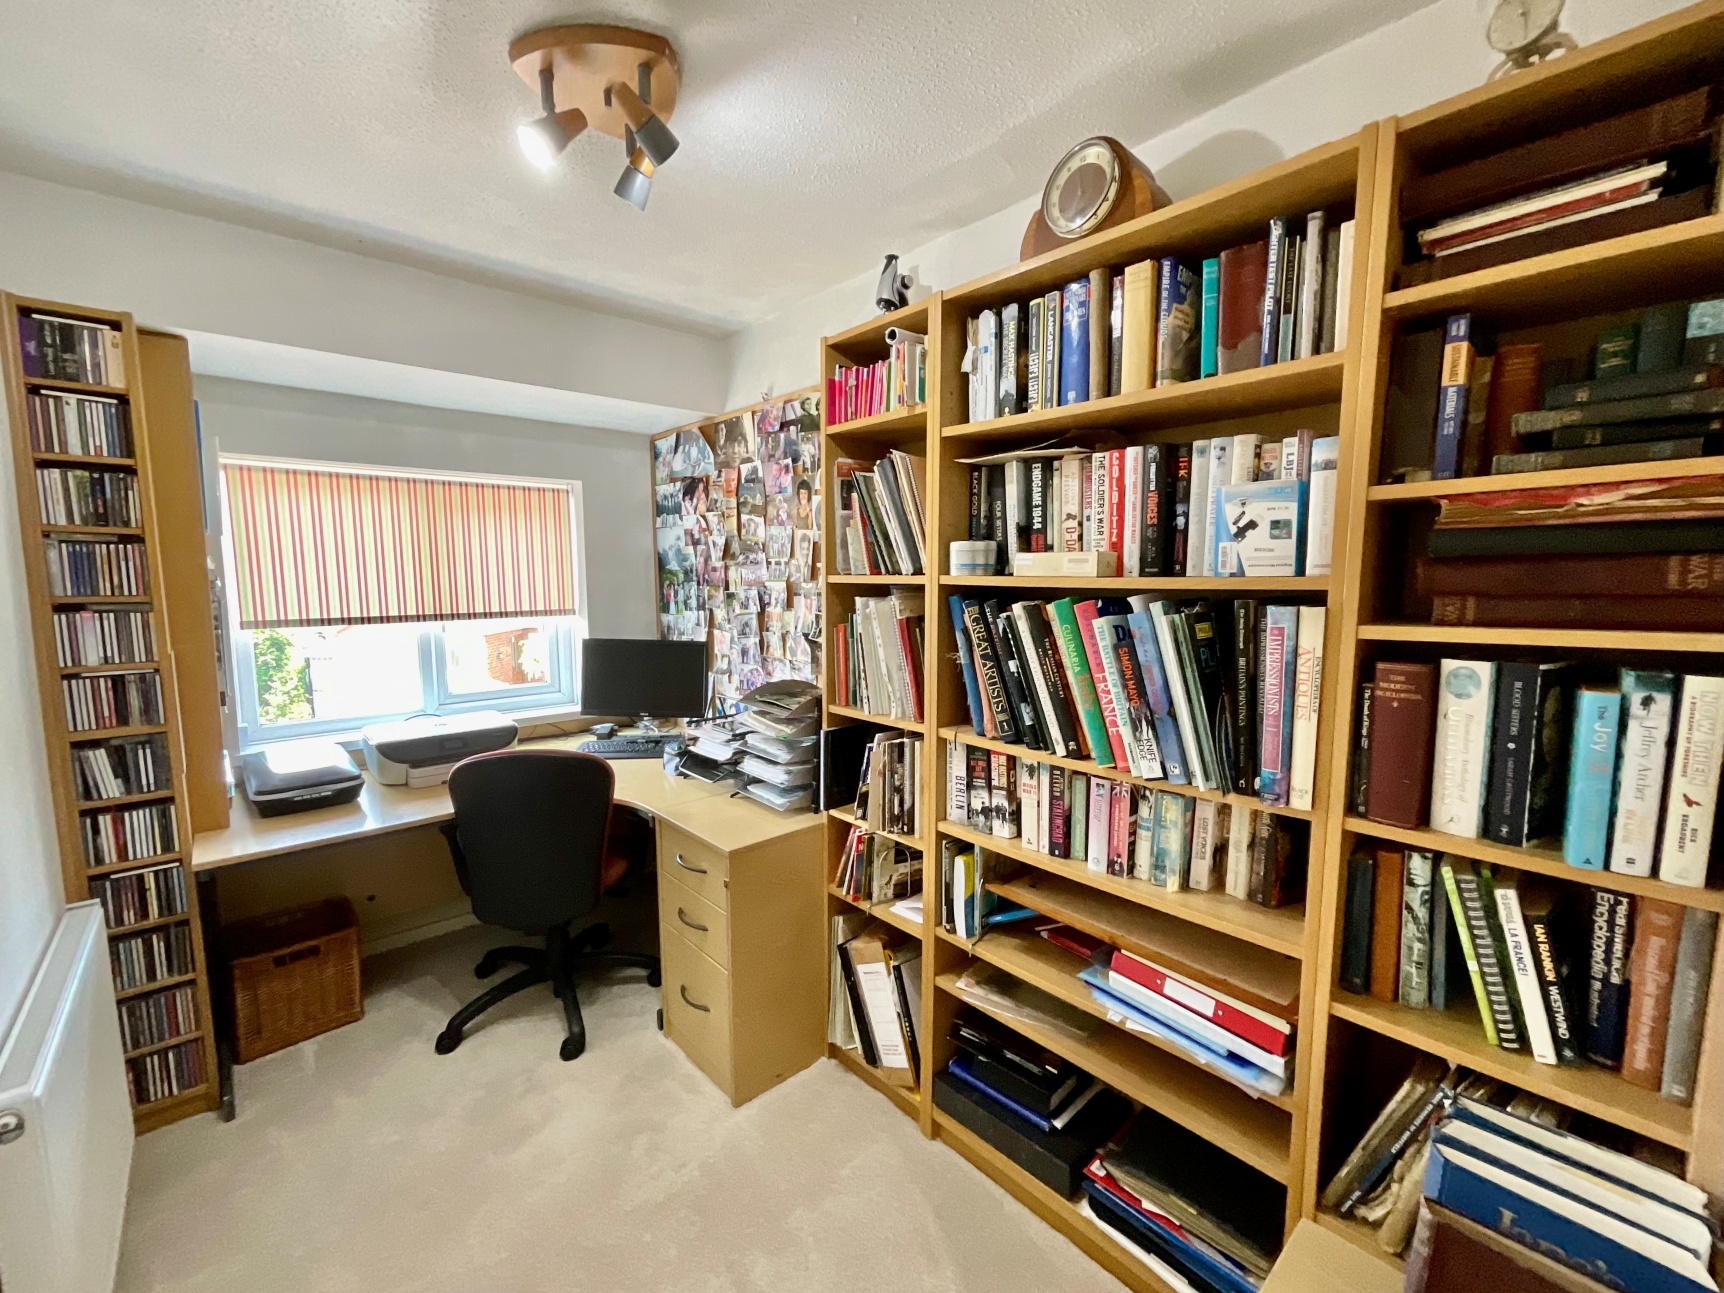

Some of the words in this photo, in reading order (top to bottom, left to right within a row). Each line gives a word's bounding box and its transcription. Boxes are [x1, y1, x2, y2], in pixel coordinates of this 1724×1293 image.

[1162, 261, 1171, 289] EMPIRE
[1267, 263, 1276, 284] TEST
[1265, 285, 1274, 311] PILOT
[1046, 310, 1054, 362] LANCASTER
[1160, 312, 1168, 340] CLOUDS
[1007, 341, 1015, 380] HASTINGS
[1444, 387, 1457, 419] MATERIALS
[1284, 452, 1294, 470] LBJ
[1032, 462, 1042, 506] ENDGAME
[1097, 474, 1105, 516] SOLDIER'S
[1111, 452, 1121, 542] COLDITZ
[1032, 507, 1042, 529] 1944
[1147, 491, 1158, 525] VOICES
[1065, 526, 1077, 552] D-DA
[1096, 518, 1104, 536] WAR
[1062, 624, 1080, 673] CULINARIA
[1096, 625, 1106, 643] THE
[971, 614, 991, 656] GREAT
[985, 659, 1006, 711] ARTISTS
[1044, 638, 1052, 649] THE
[1053, 673, 1064, 698] CENTURY
[1102, 644, 1117, 678] BATTLE
[1118, 647, 1134, 679] SIMON
[1127, 680, 1140, 707] MAYO
[1238, 657, 1247, 689] BRITAIN'S
[1267, 636, 1282, 716] IMPRESSIONISTS
[1110, 679, 1119, 690] OF
[1295, 646, 1312, 721] ANTIQUES
[1312, 656, 1322, 704] ENCYCLOPEDIA
[1512, 681, 1523, 707] BLOOD
[1040, 696, 1055, 728] ENGLAND
[1094, 672, 1120, 736] FRANCE
[1113, 691, 1129, 727] BRITAIN
[1238, 690, 1246, 727] PAINTINGS
[1312, 705, 1318, 714] OF
[1597, 706, 1607, 720] The
[1686, 702, 1696, 735] BIOGRAPHY
[1700, 691, 1719, 735] NOW
[1510, 708, 1520, 735] SISTERS
[1589, 722, 1612, 752] Joy
[1136, 740, 1148, 762] EDGE
[1143, 738, 1157, 764] KNIFE
[1636, 722, 1658, 761] Jeffrey
[1680, 744, 1691, 778] YORKSHIRE
[1687, 740, 1713, 787] THEN
[955, 775, 966, 811] BERLIN
[1633, 764, 1653, 802] Archer
[1052, 800, 1064, 843] STALINGRAD
[1201, 817, 1209, 836] LOST
[1678, 814, 1689, 854] BROADBENT
[1690, 828, 1699, 843] RICK
[1508, 928, 1518, 938] LA
[1533, 924, 1549, 942] IAN
[1590, 891, 1614, 979] Encyclopedia
[1511, 940, 1528, 977] FRANCE!
[1536, 943, 1557, 981] RANKIN
[1548, 985, 1570, 1039] WESTWIND
